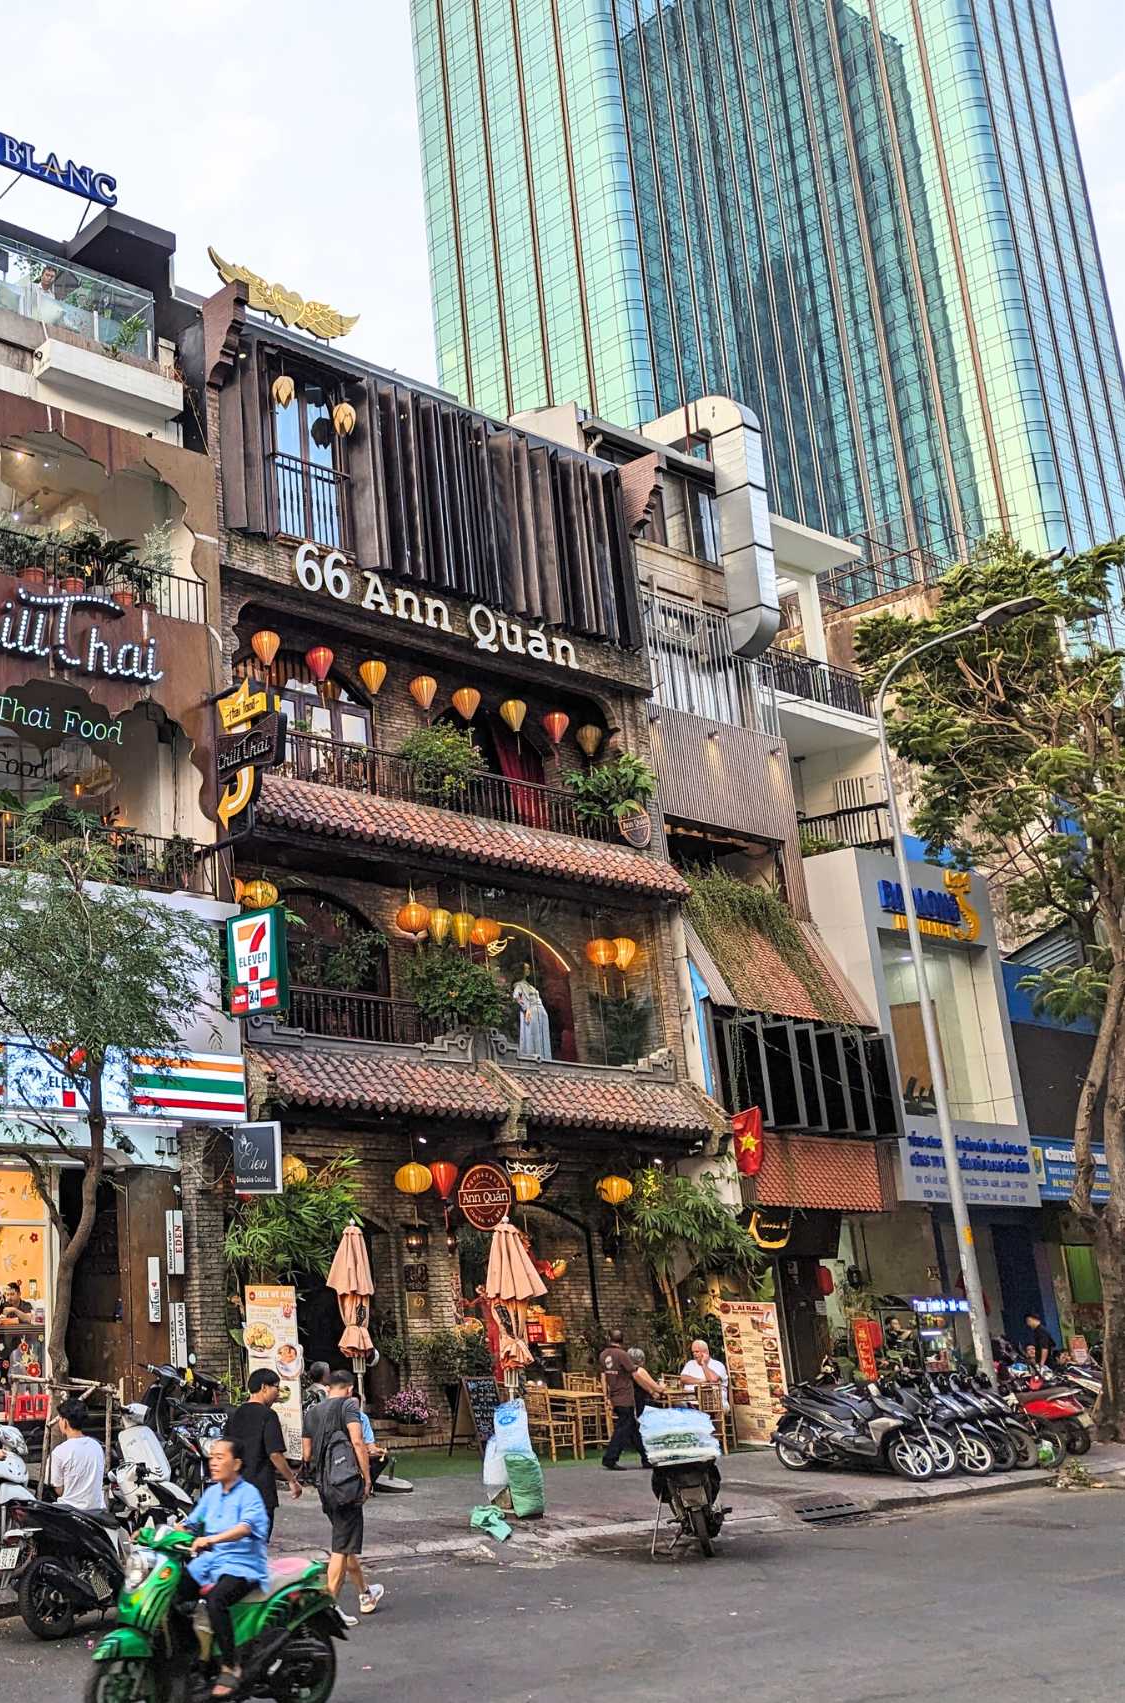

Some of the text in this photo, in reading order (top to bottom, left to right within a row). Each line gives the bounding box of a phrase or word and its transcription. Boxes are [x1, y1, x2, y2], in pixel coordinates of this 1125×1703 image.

[3, 134, 117, 206] BLANC
[295, 543, 580, 670] 66 Ann Quán
[62, 710, 123, 745] Food
[249, 989, 260, 1004] 24
[462, 1190, 508, 1204] Ann Quán
[175, 1225, 183, 1254] EDEN
